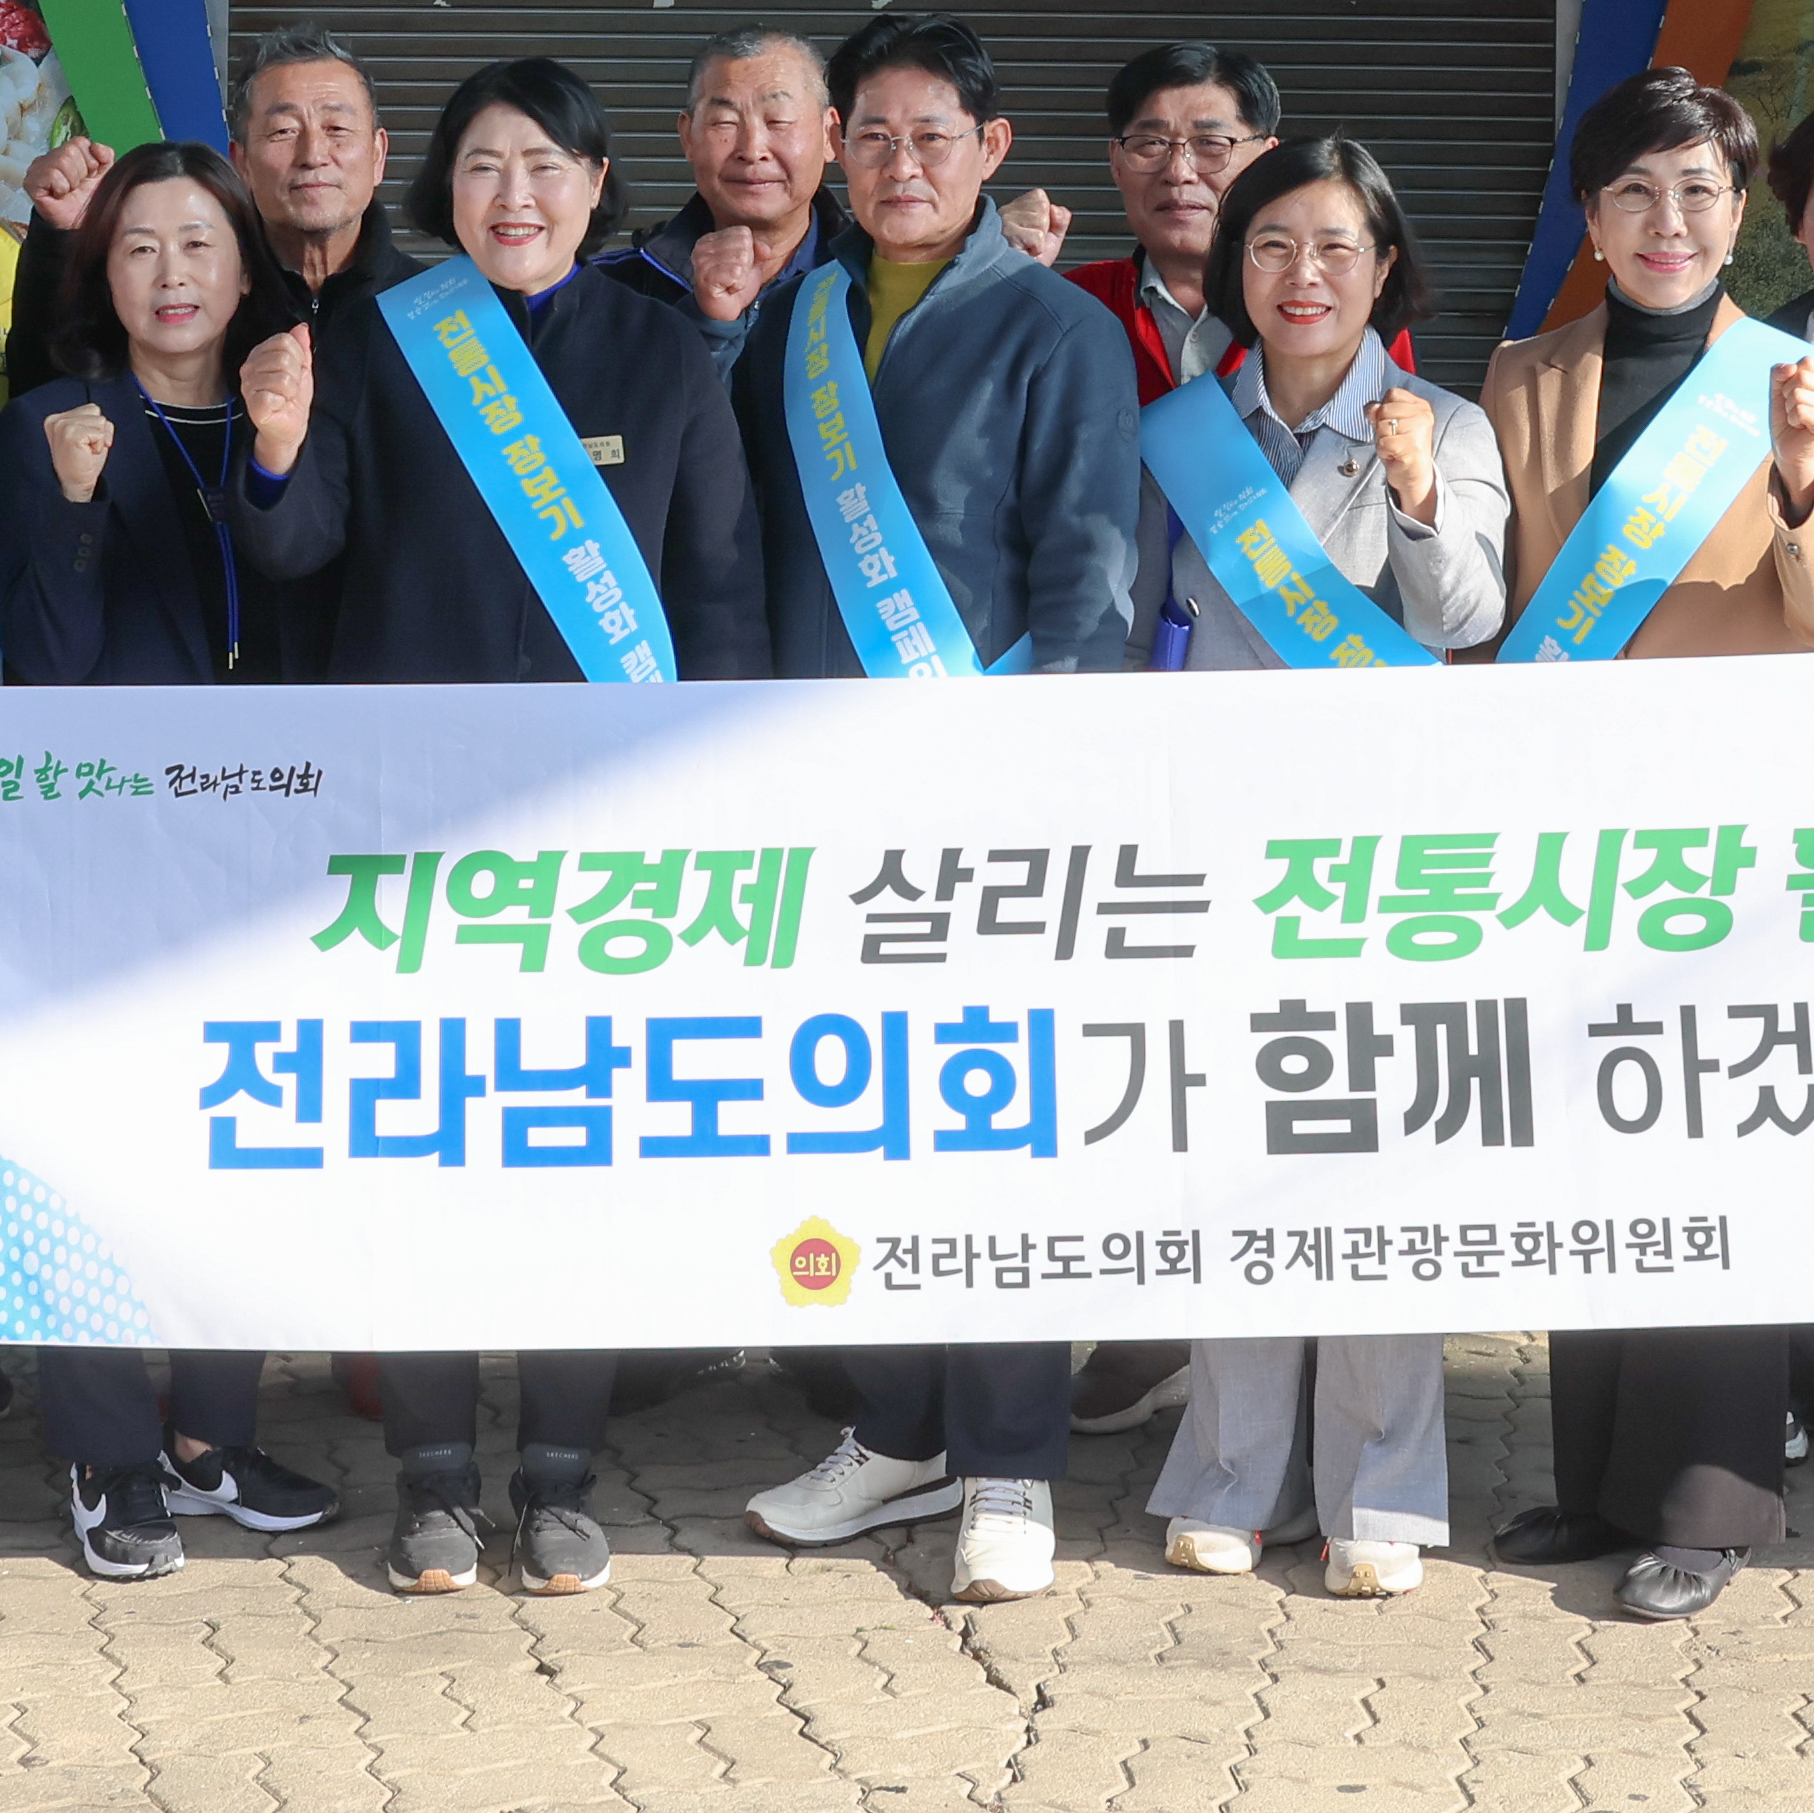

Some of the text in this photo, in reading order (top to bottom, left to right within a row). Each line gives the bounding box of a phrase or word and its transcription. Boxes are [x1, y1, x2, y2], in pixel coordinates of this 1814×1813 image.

[432, 309, 524, 435] 전통시장
[501, 433, 586, 541] 장보기
[562, 539, 640, 647] 활성화
[836, 482, 899, 589] 활성화
[1235, 518, 1340, 643] 전통시장
[1555, 544, 1638, 645] 장보기
[33, 751, 69, 800] 할
[74, 756, 155, 800] 맛나는
[164, 760, 323, 802] 전라남도의회
[309, 844, 816, 974] 지역경제
[848, 841, 1212, 969] 살리는
[1251, 821, 1758, 964] 전통시장
[200, 1004, 1208, 1170] 전라남도의회가
[1249, 997, 1535, 1158] 함께
[792, 1252, 837, 1278] 의회
[872, 1213, 1734, 1291] 전라남도의회 경제관광문화위원회
